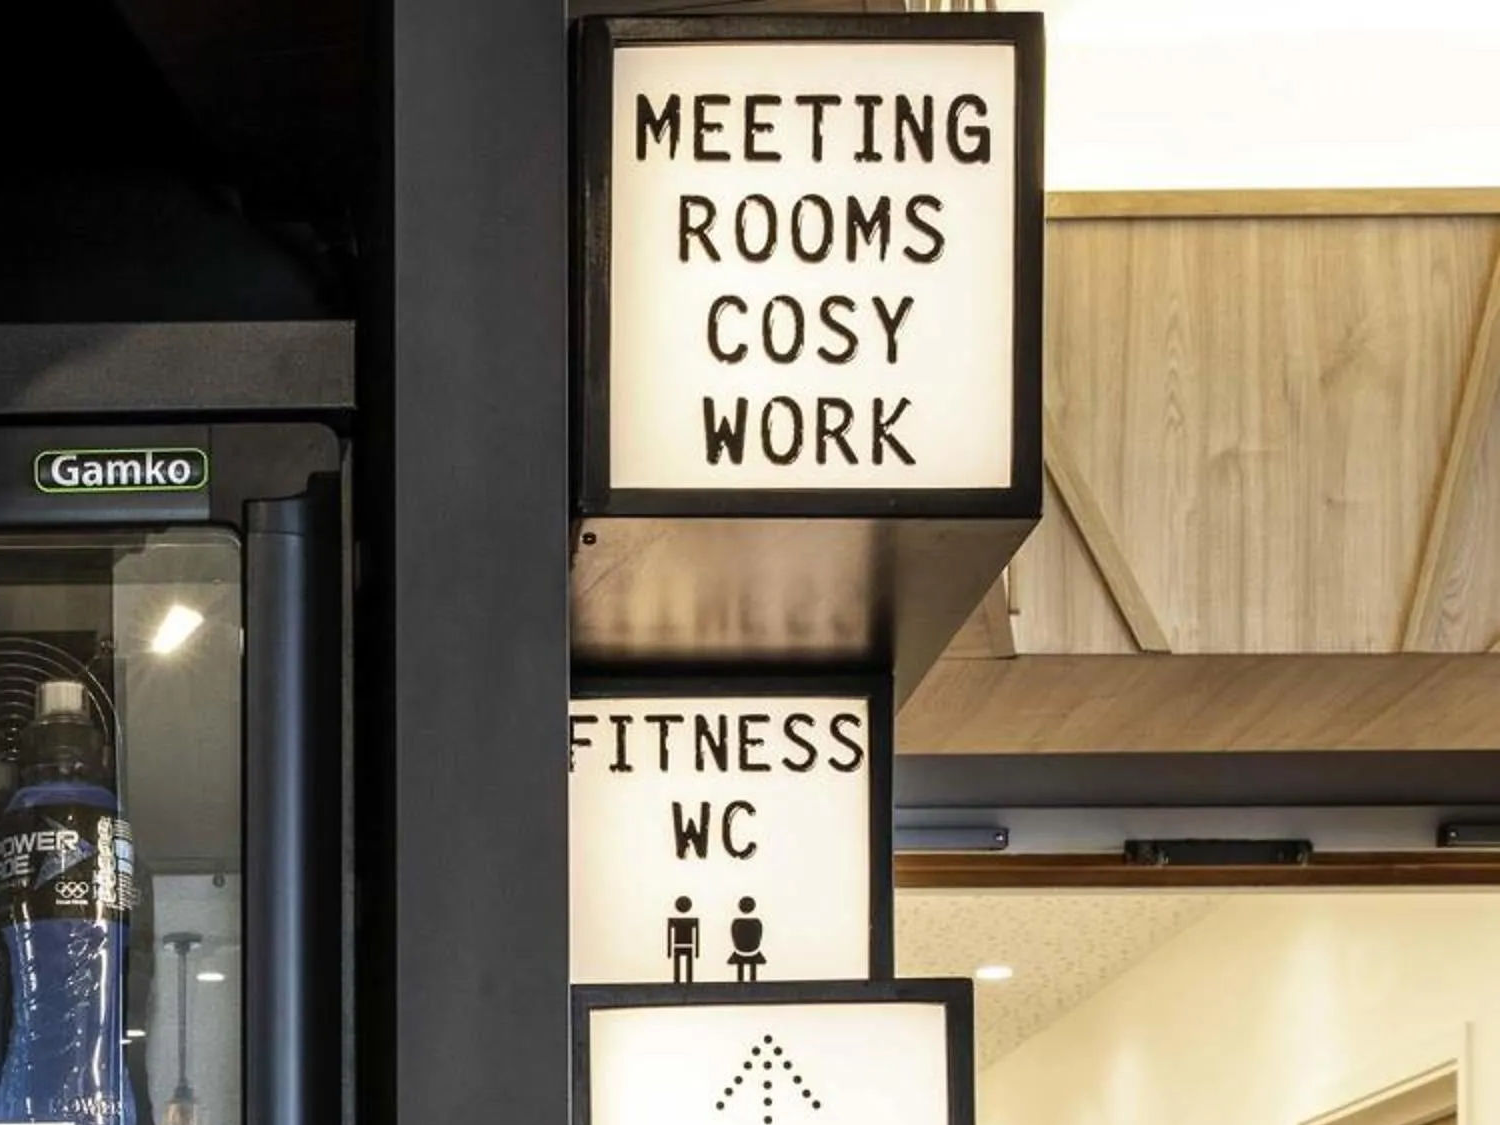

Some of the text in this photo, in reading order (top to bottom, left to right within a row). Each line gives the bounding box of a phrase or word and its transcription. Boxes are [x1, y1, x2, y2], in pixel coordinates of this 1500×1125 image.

[635, 92, 992, 164] MEETING
[678, 193, 945, 263] ROOMS
[706, 294, 915, 364] COSY
[702, 395, 917, 466] WORK
[51, 452, 192, 487] Gamko
[569, 712, 865, 773] FITNESS
[0, 829, 79, 859] OWER
[671, 800, 758, 860] WC
